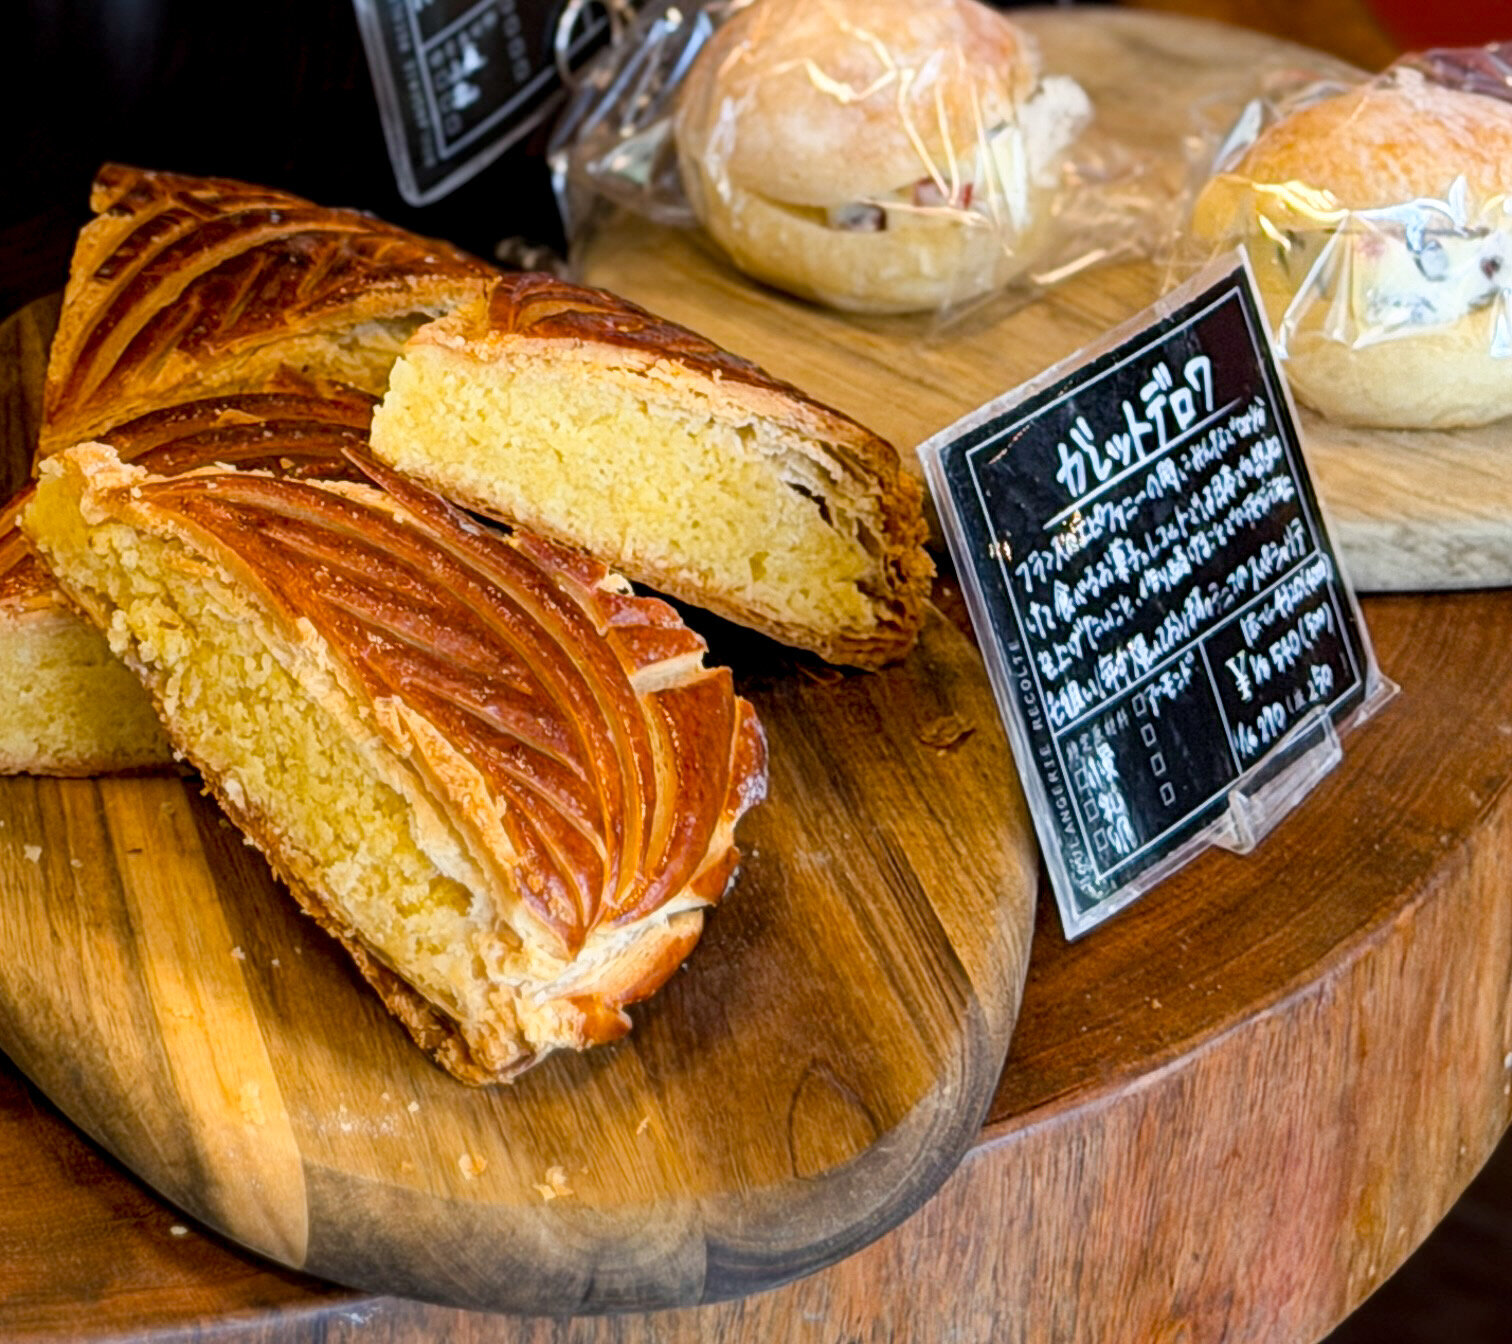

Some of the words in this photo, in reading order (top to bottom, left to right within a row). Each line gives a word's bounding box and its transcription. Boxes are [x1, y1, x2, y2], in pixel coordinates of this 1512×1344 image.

[1057, 356, 1213, 497] ガレットデロワ
